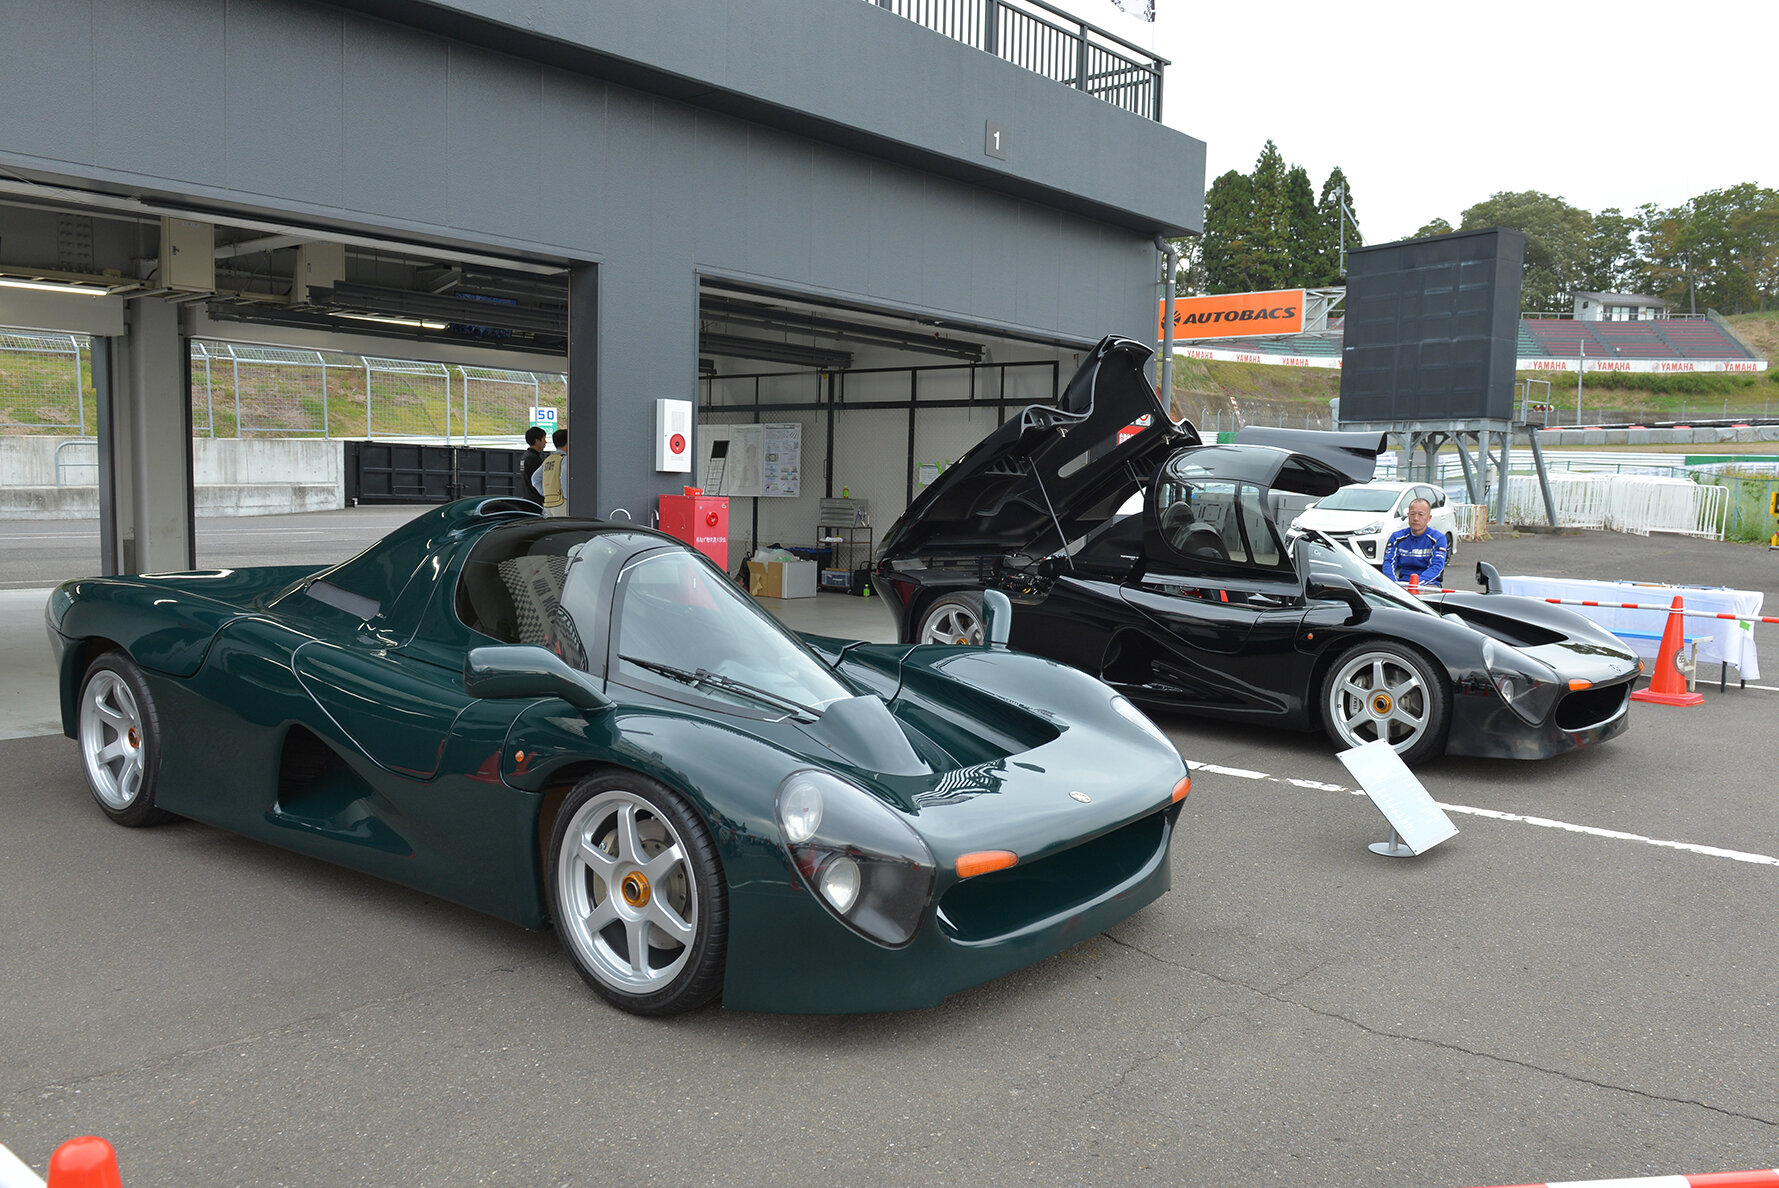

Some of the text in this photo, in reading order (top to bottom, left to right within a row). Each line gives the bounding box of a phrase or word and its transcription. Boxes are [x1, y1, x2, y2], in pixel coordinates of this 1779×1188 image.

[994, 131, 1000, 150] 1
[1182, 306, 1297, 325] AUTOBACS
[1187, 350, 1213, 360] YAMAHA
[1236, 353, 1261, 364] YAMAHA
[1282, 357, 1309, 367] YAMAHA
[1532, 360, 1566, 370] YAMAHA
[1596, 361, 1631, 371] YAMAHA
[1660, 361, 1695, 371] YAMAHA
[1723, 362, 1757, 372] YAMAHA
